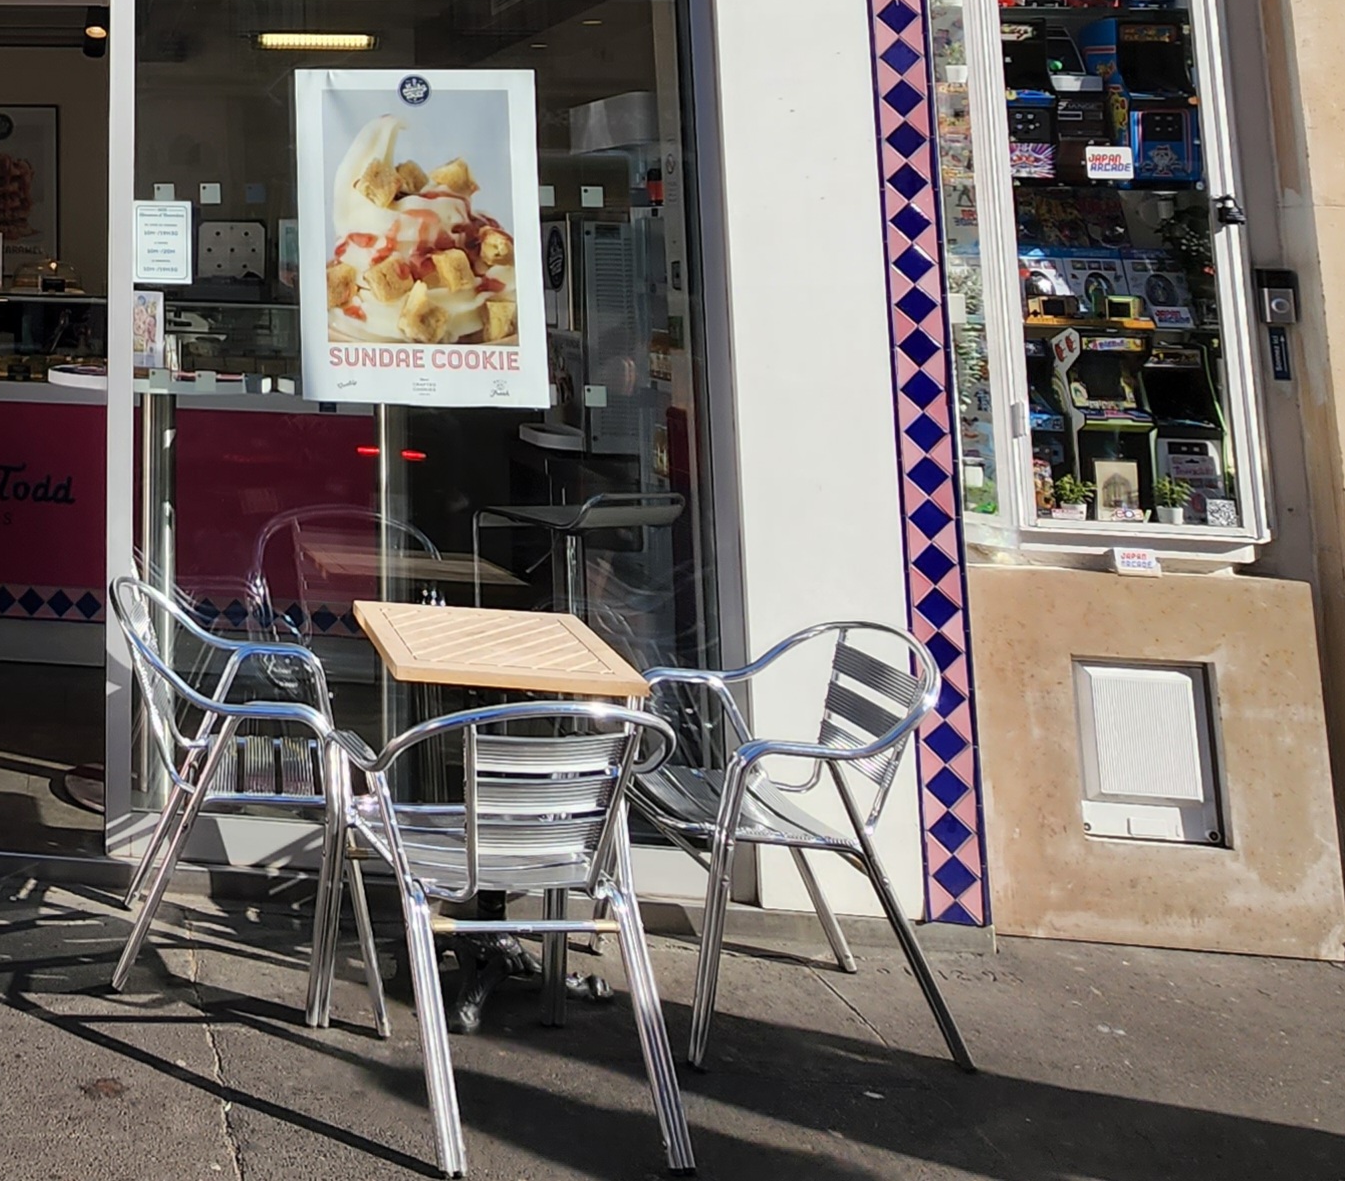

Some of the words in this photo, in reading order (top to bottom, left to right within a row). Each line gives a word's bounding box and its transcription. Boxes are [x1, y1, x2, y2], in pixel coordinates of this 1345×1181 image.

[1088, 153, 1122, 163] JAPAN
[1090, 163, 1131, 172] ARCADE
[4, 245, 44, 255] ARAMEL
[329, 347, 425, 368] SUNDAE
[431, 349, 521, 371] COOKIE
[1120, 552, 1147, 560] JAPAN
